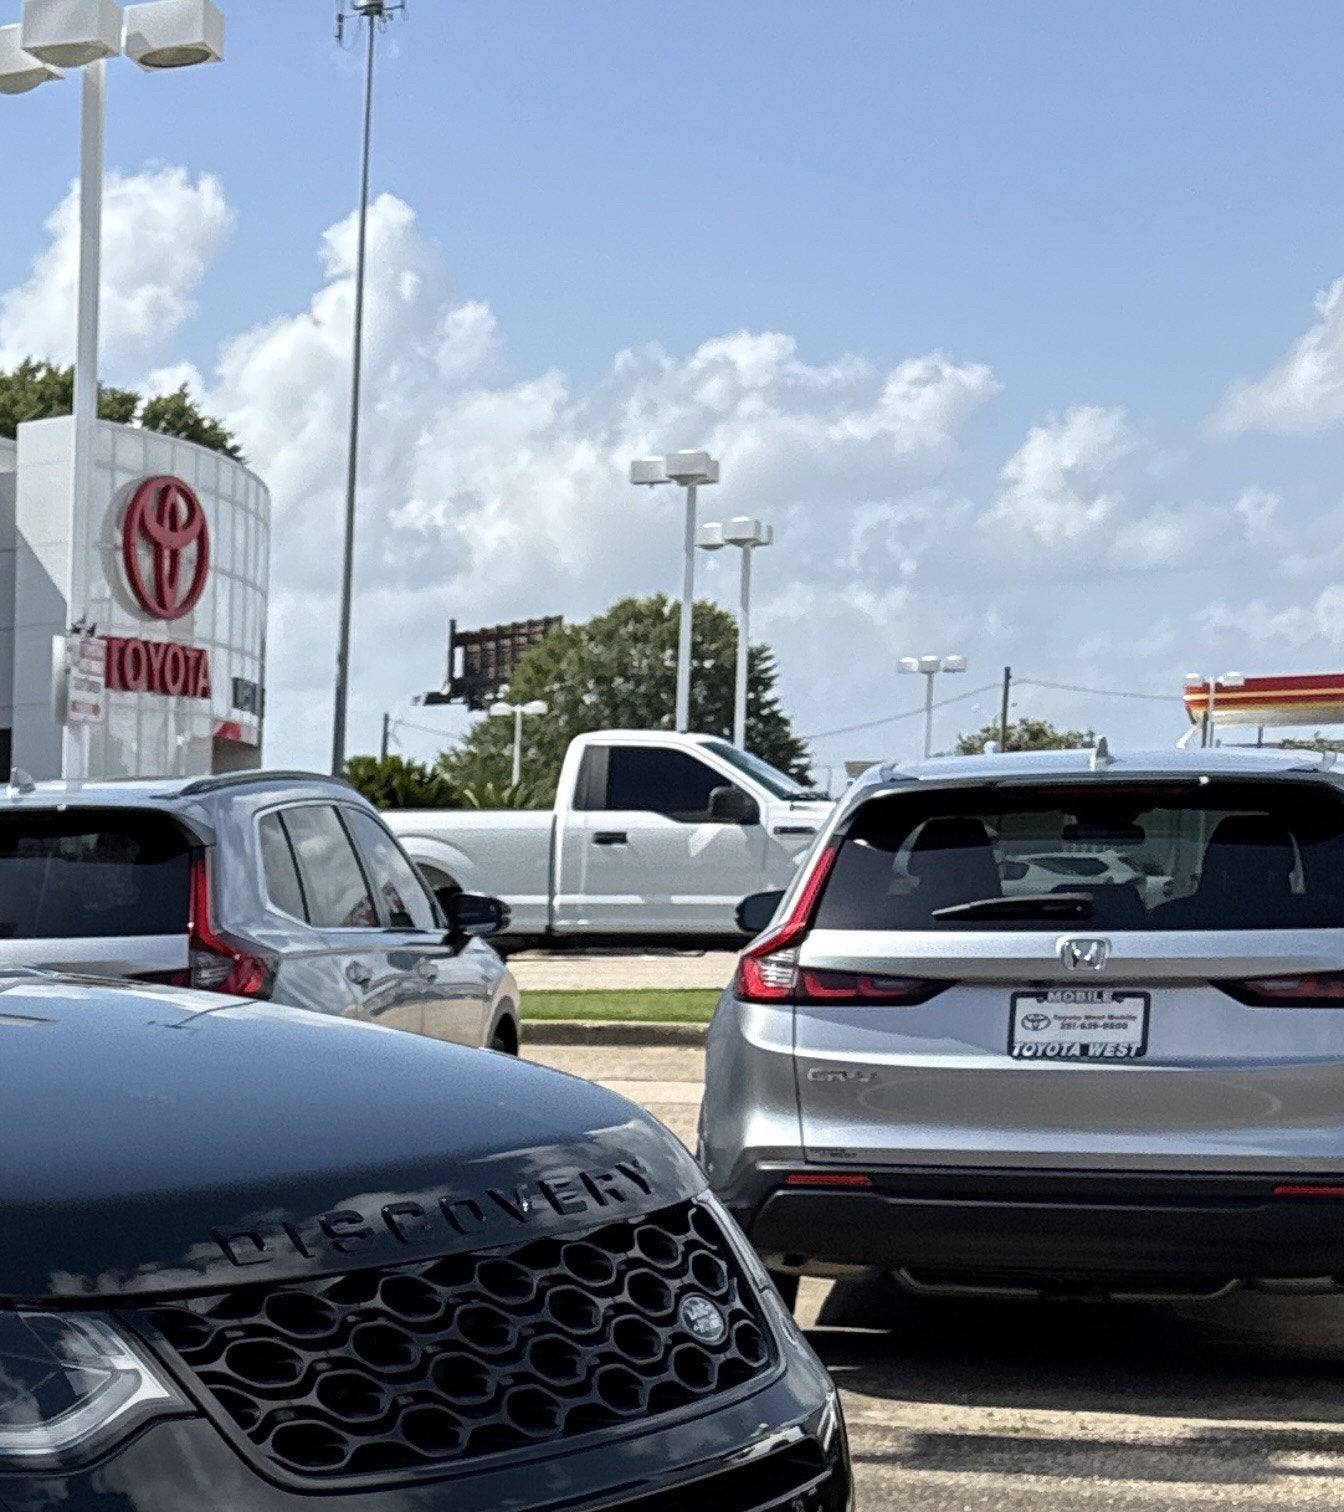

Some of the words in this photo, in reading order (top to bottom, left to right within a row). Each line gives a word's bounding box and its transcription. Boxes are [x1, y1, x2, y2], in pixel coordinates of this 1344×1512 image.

[105, 636, 211, 698] TOYOTA
[1047, 991, 1112, 1004] MOBILE
[1012, 1042, 1081, 1057] TOYOTA
[1088, 1042, 1141, 1057] WEST
[210, 1161, 654, 1268] DISCOVERY
